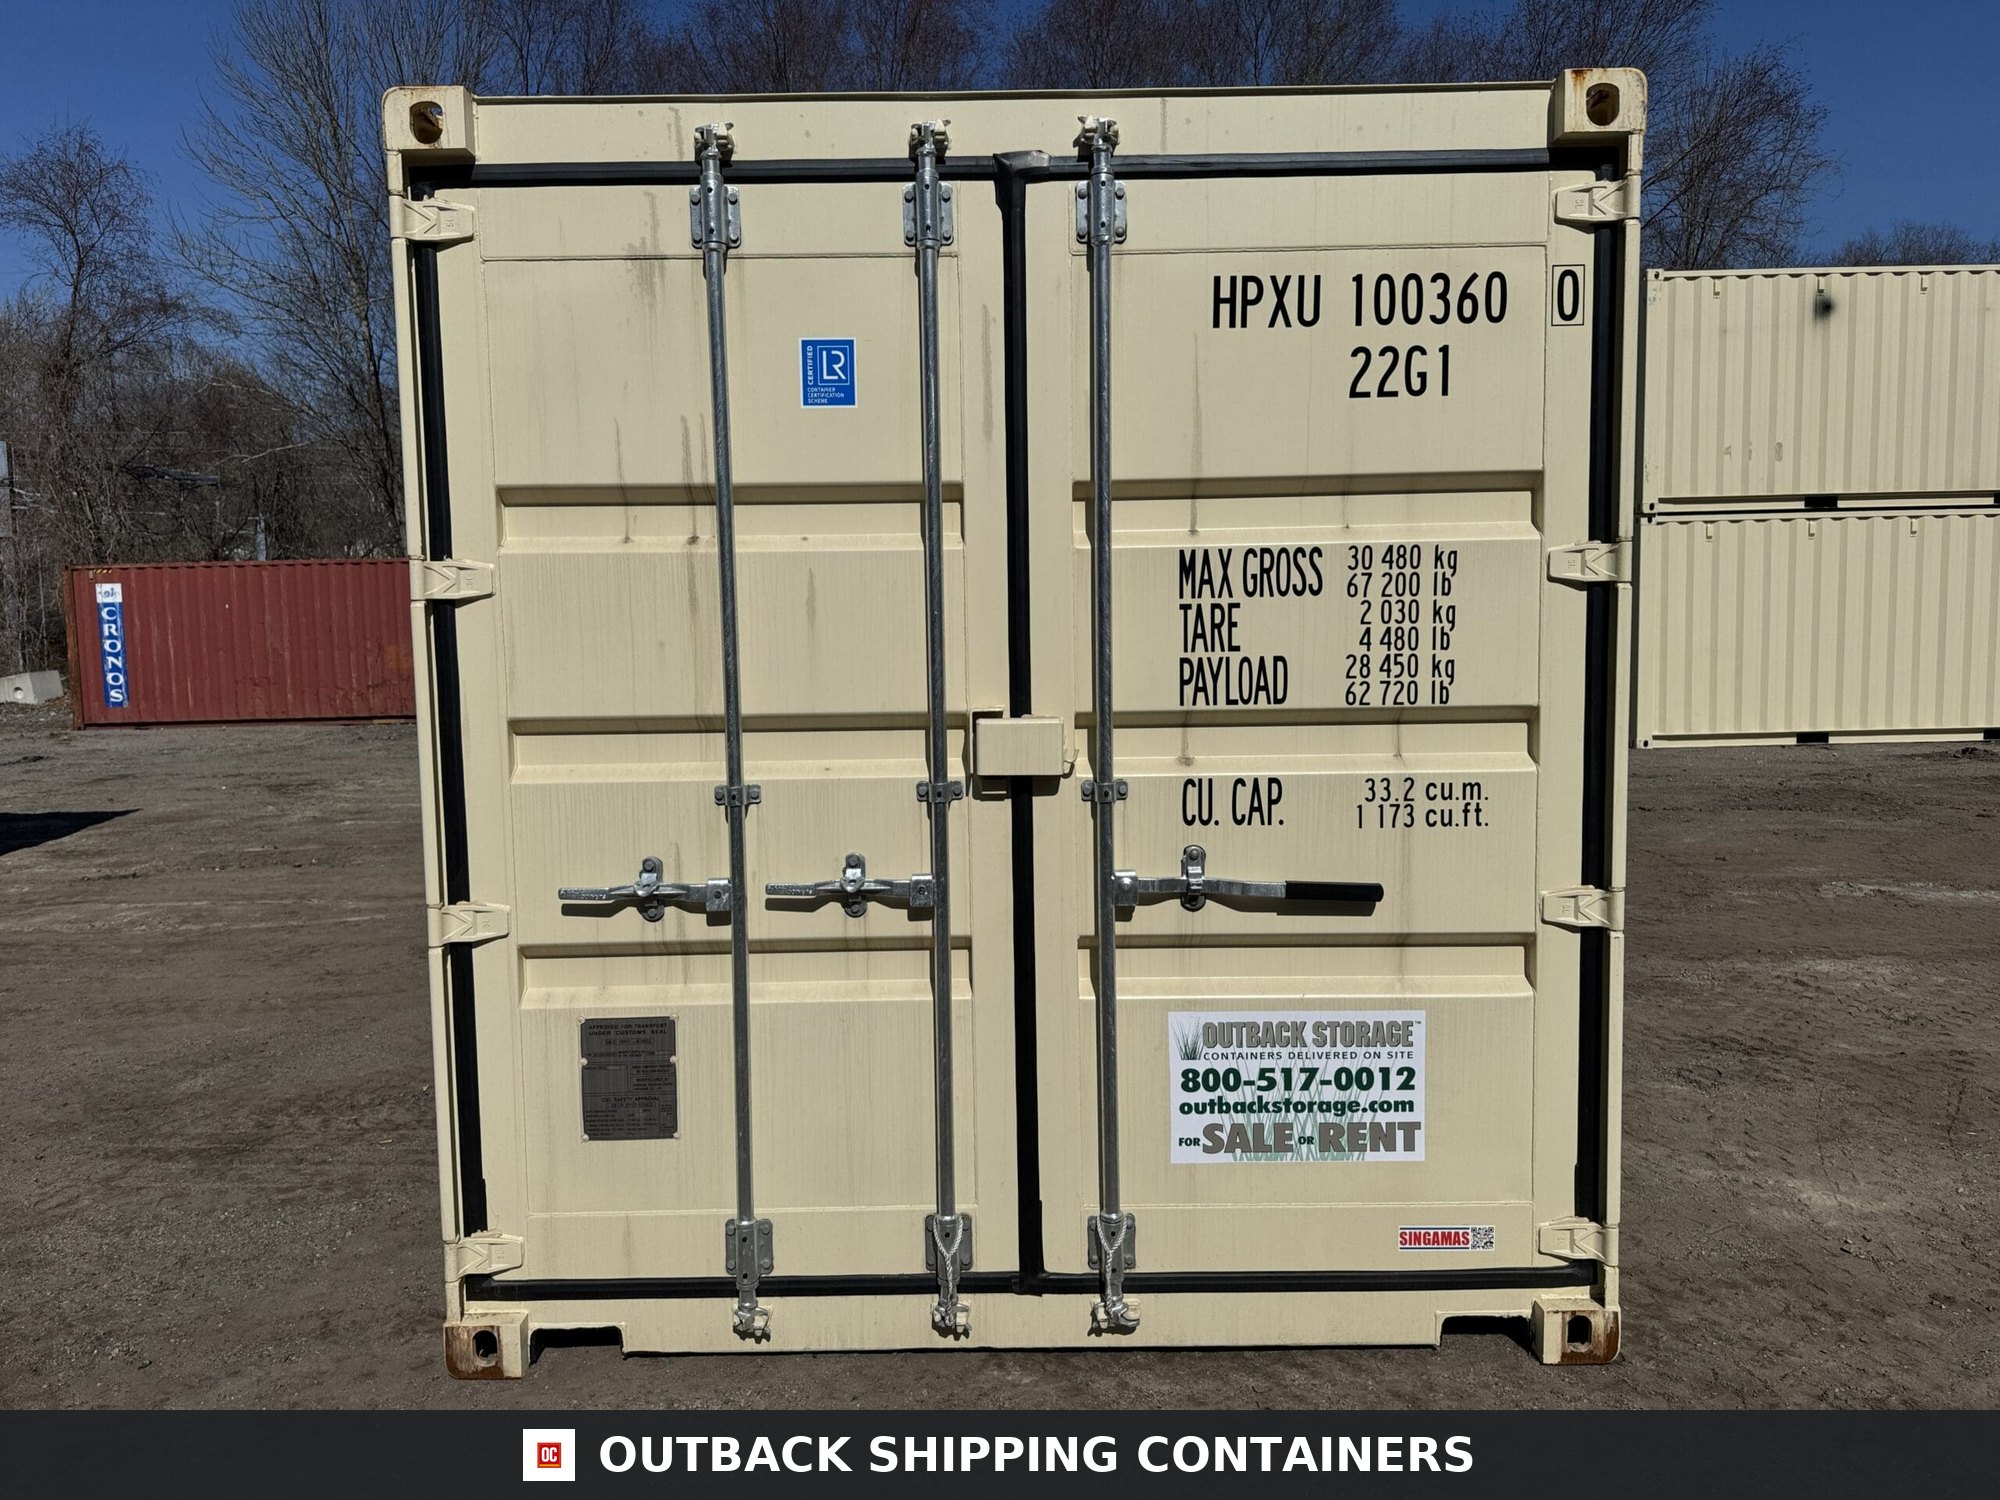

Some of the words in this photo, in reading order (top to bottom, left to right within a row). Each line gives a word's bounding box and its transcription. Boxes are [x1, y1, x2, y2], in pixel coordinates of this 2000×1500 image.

[1212, 274, 1322, 329] HPXU
[1351, 270, 1508, 327] 100360
[1556, 269, 1580, 322] 0
[806, 345, 814, 386] CERTIFIED
[822, 350, 846, 379] LR
[1349, 344, 1451, 399] 22G1
[1178, 548, 1234, 599] MAX
[1242, 546, 1324, 598] GROSS
[1347, 545, 1374, 571] 30
[1380, 544, 1422, 570] 480
[1433, 544, 1459, 578] kg
[1346, 573, 1373, 598] 67
[1380, 572, 1421, 597] 200
[1432, 571, 1452, 597] lb
[1178, 602, 1242, 653] TARE
[1359, 600, 1372, 625] 2
[1380, 599, 1420, 625] 030
[1432, 599, 1457, 632] kg
[1358, 627, 1372, 652] 4
[1379, 626, 1420, 651] 480
[1431, 626, 1451, 651] lb
[101, 606, 125, 703] CRONOS
[1178, 655, 1289, 707] PAYLOAD
[1345, 654, 1371, 680] 28
[1378, 653, 1419, 679] 450
[1431, 653, 1456, 687] kg
[1344, 681, 1371, 706] 62
[1379, 680, 1419, 706] 720
[1431, 680, 1450, 705] lb
[1181, 777, 1221, 827] CU.
[1231, 776, 1285, 827] CAP.
[1364, 777, 1416, 803] 33.2
[1424, 781, 1490, 802] cu.m.
[1356, 804, 1364, 829] 1
[1377, 803, 1416, 829] 173
[1424, 802, 1490, 828] cu.ft.
[1202, 1021, 1308, 1049] OUTBACK
[1203, 1051, 1283, 1061] CONTAINERS
[1288, 1051, 1358, 1060] DELIVERED
[1363, 1050, 1381, 1059] ON
[1387, 1050, 1414, 1059] SITE
[1180, 1066, 1417, 1093] 800-517-0012
[1178, 1095, 1415, 1117] outbackstorage.com
[1178, 1137, 1201, 1147] FOR
[1202, 1122, 1294, 1155] SALE
[1298, 1136, 1315, 1145] OR
[1318, 1121, 1422, 1153] RENT
[1399, 1231, 1470, 1246] SINGAMAS
